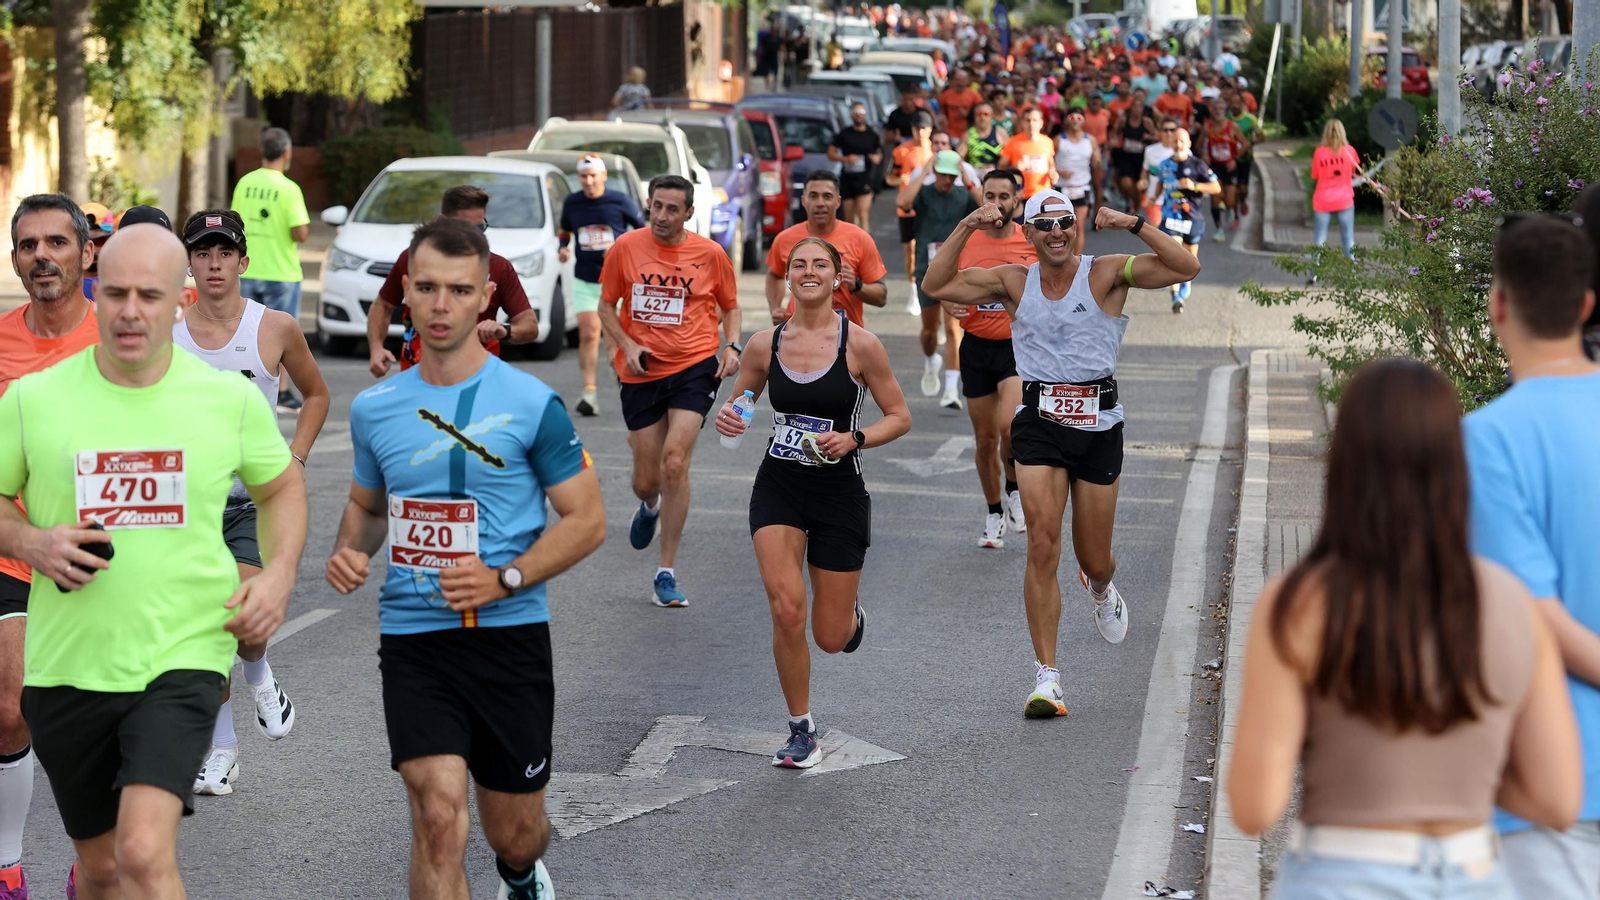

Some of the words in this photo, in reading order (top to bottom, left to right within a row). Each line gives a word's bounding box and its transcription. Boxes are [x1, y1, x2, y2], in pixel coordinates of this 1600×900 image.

[643, 298, 671, 312] 427
[1053, 398, 1084, 414] 252
[784, 428, 804, 447] 67
[100, 477, 157, 503] 470
[407, 523, 452, 549] 420
